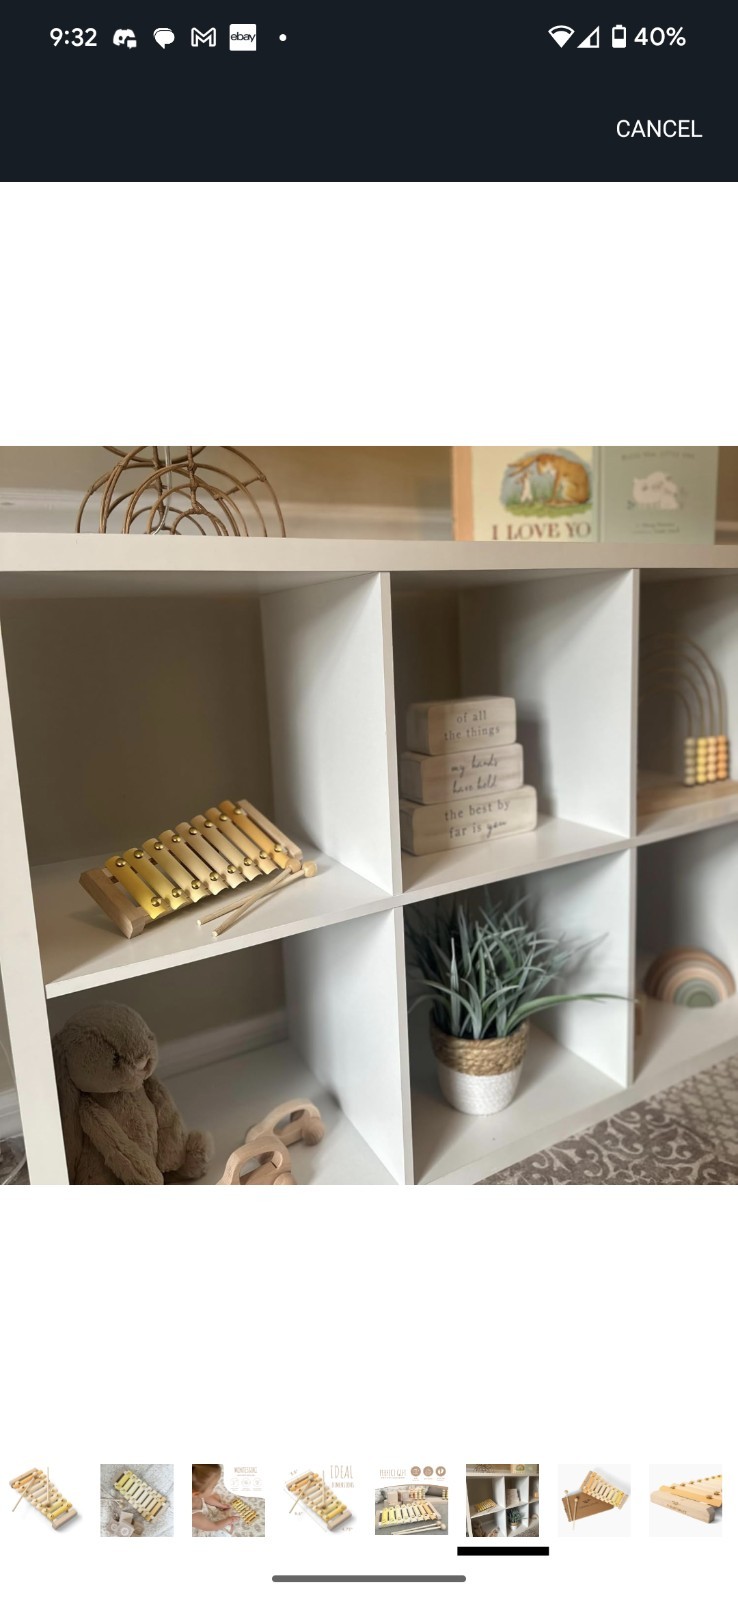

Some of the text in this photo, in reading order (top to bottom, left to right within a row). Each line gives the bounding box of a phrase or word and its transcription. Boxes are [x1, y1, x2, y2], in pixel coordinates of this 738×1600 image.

[50, 27, 98, 47] 9:32
[231, 32, 255, 43] ebay
[634, 27, 686, 47] 40%
[616, 119, 702, 138] CANCEL
[491, 525, 498, 540] I
[507, 523, 560, 540] LOVE
[457, 711, 487, 723] of all
[444, 726, 500, 740] the things
[451, 754, 498, 777] my hands
[445, 800, 510, 821] the best by
[449, 821, 506, 838] far is you
[330, 1465, 353, 1479] IDEAL
